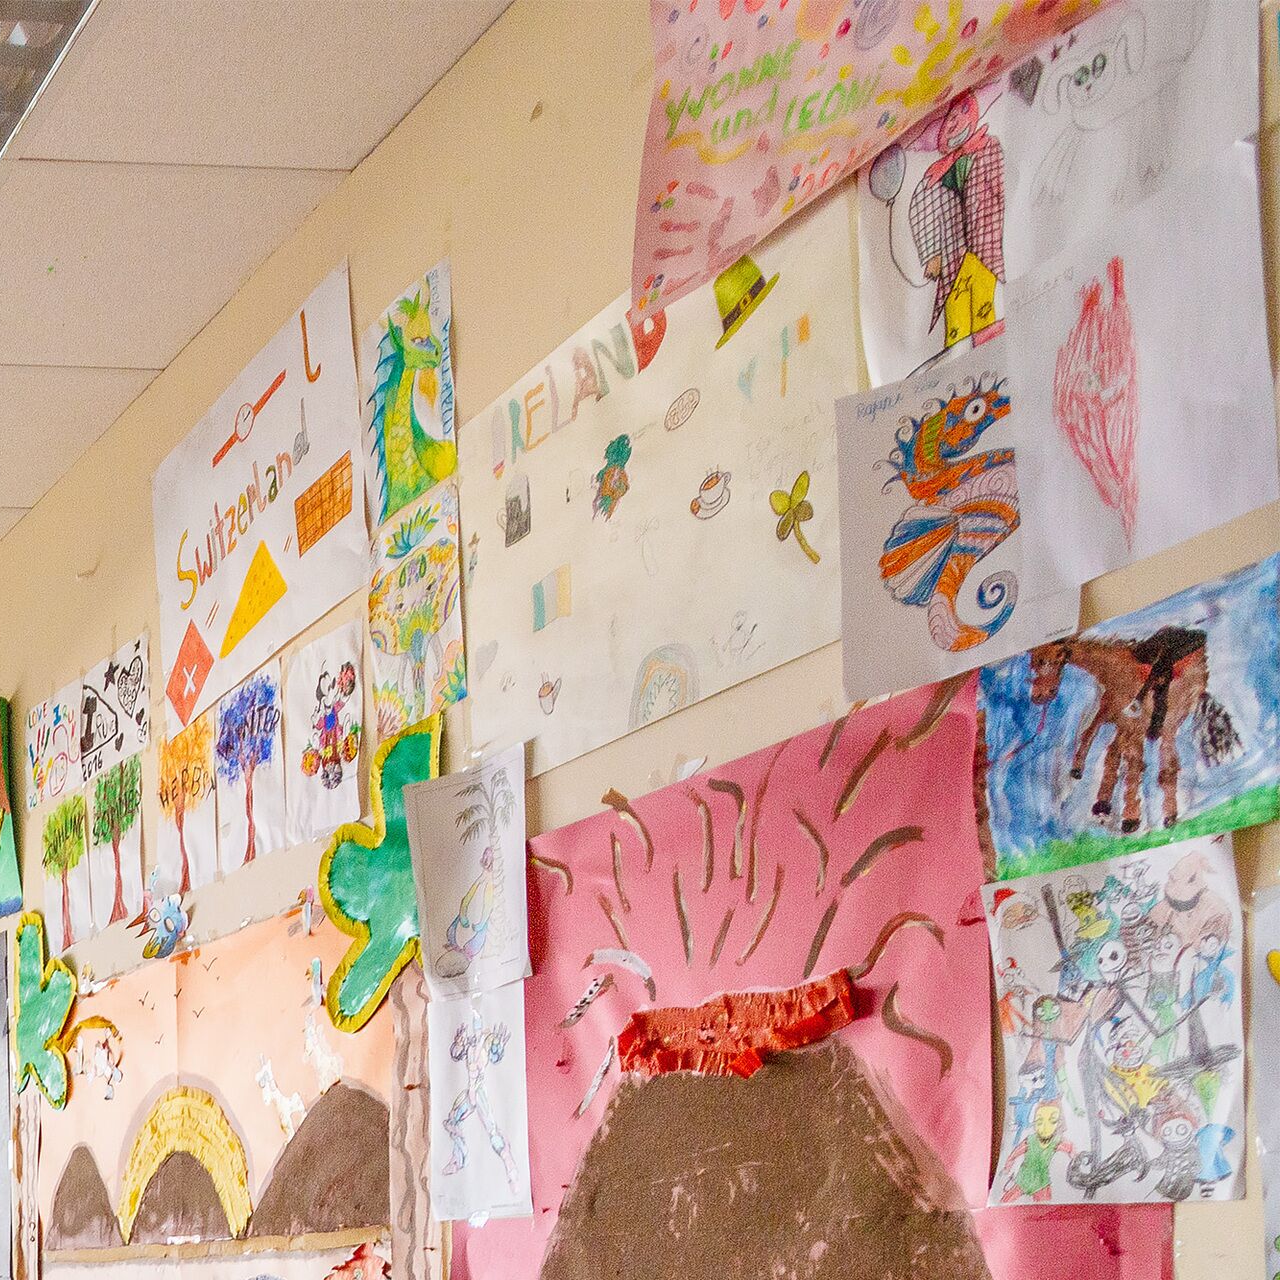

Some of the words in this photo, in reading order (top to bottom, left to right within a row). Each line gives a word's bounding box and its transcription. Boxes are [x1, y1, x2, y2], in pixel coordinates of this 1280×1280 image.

[709, 83, 780, 145] und
[490, 306, 669, 480] IRELAND
[176, 397, 311, 610] Switzerland
[28, 701, 48, 729] LOVE
[81, 750, 103, 782] 2016
